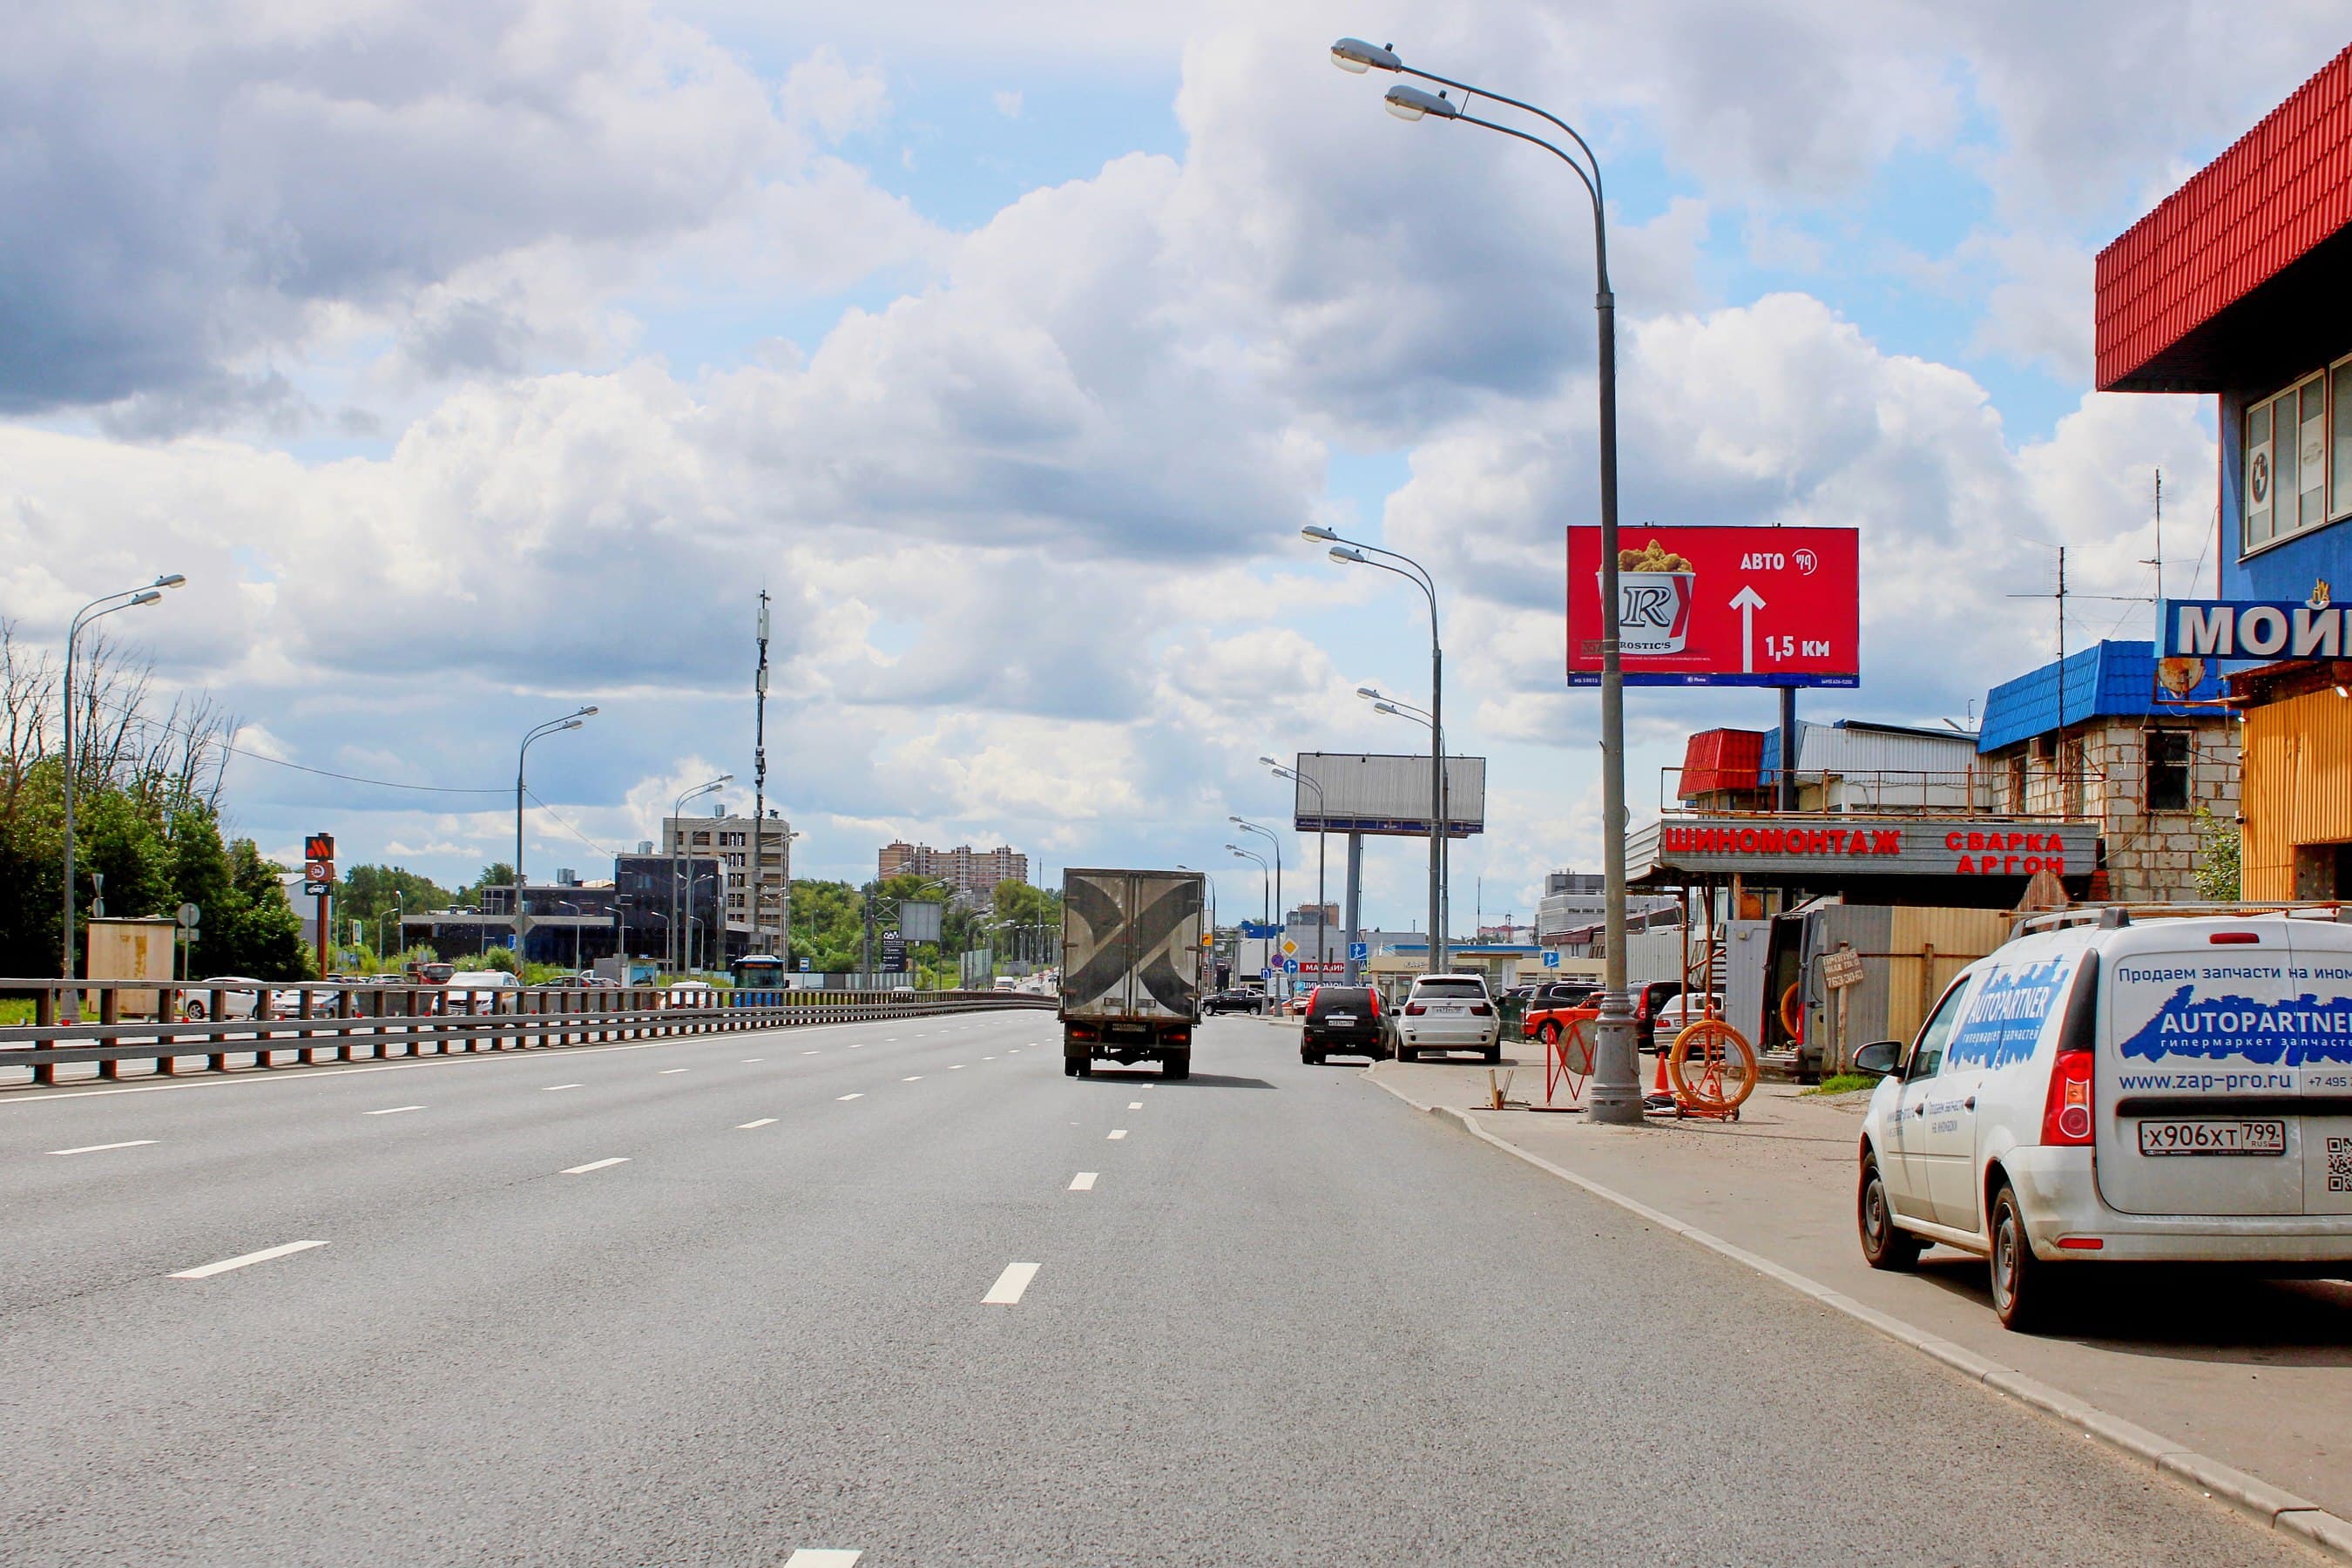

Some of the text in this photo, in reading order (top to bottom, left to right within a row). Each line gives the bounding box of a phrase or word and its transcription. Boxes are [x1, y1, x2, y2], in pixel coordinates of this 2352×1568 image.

[1740, 552, 1785, 571] АВТО
[1619, 585, 1672, 628] R
[2180, 598, 2352, 656] МОЙ
[1619, 641, 1672, 650] ROSTIC'S
[1765, 635, 1794, 662] 1,5
[1666, 828, 1901, 855] ШИНОМОНТАЖ
[1945, 831, 2064, 852] СВАРКА
[1956, 855, 2065, 875] АРГОН
[2119, 968, 2196, 983] Продаем
[2202, 968, 2281, 979] запчасти
[2288, 968, 2308, 979] на
[1968, 986, 2050, 1024] AUTOPARTNER
[2160, 1011, 2352, 1034] AUTOPARTNE
[2160, 1038, 2272, 1049] гипермаркет
[2119, 1072, 2291, 1092] www.zap-pro.ru
[2308, 1077, 2322, 1086] +7
[2325, 1077, 2347, 1087] 495
[2243, 1124, 2276, 1140] 799
